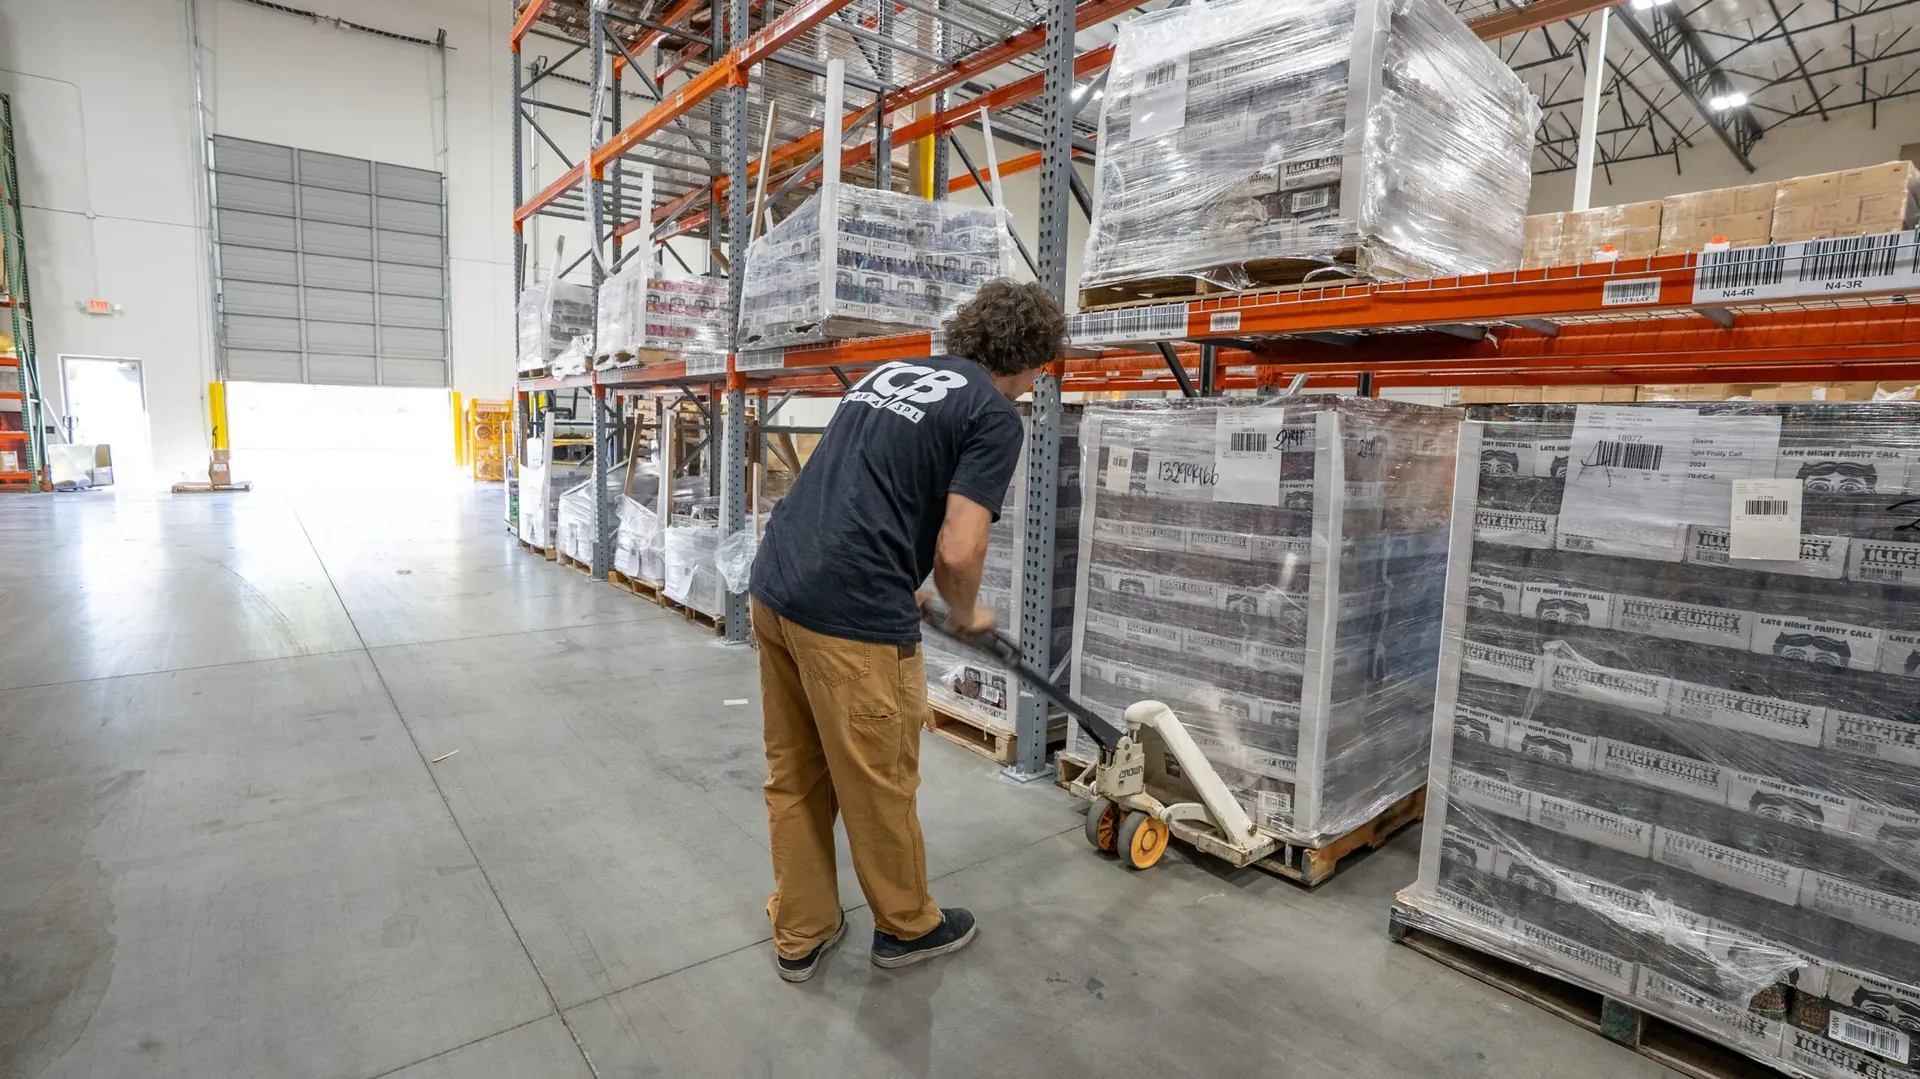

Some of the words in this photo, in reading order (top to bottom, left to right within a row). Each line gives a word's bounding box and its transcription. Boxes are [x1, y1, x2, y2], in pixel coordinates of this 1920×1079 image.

[1722, 288, 1755, 298] N4-4R
[1825, 280, 1862, 290] N4-3R
[893, 403, 919, 421] 3PL
[1617, 434, 1643, 442] 18977
[1812, 450, 1836, 458] NIGHT
[1838, 450, 1873, 458] FRUITY
[1875, 451, 1901, 459] CALL
[1500, 517, 1545, 530] ELIXIRS
[1542, 587, 1563, 596] NIGHT
[1564, 590, 1587, 599] FRUITY
[1588, 593, 1605, 601] CALL
[1627, 602, 1676, 619] ILLICIT
[1678, 611, 1738, 629] ELIXIRS
[1760, 617, 1782, 627] LATE
[1783, 620, 1812, 631] NIGHT
[1814, 624, 1848, 635] FRUITY
[1850, 629, 1874, 639] CALL
[1889, 634, 1914, 644] LATE
[1488, 652, 1533, 671] ELIXIRS
[1469, 708, 1488, 719] FRUITY
[1490, 715, 1504, 724] CALL
[1741, 701, 1804, 723] ELIXIRS
[1528, 724, 1547, 733] NIGHT
[1548, 729, 1571, 740] FRUITY
[1571, 735, 1588, 744] CALL
[1610, 745, 1656, 766] ILLICIT
[1659, 757, 1716, 782] ELIXIRS
[1760, 780, 1788, 792] NIGHT
[1789, 787, 1821, 799] FRUITY
[1823, 795, 1846, 806] CALL
[1476, 841, 1489, 850] CALL
[1717, 923, 1737, 932] LATE
[1799, 954, 1821, 966] CALL
[1801, 1038, 1861, 1070] ILLICIT
